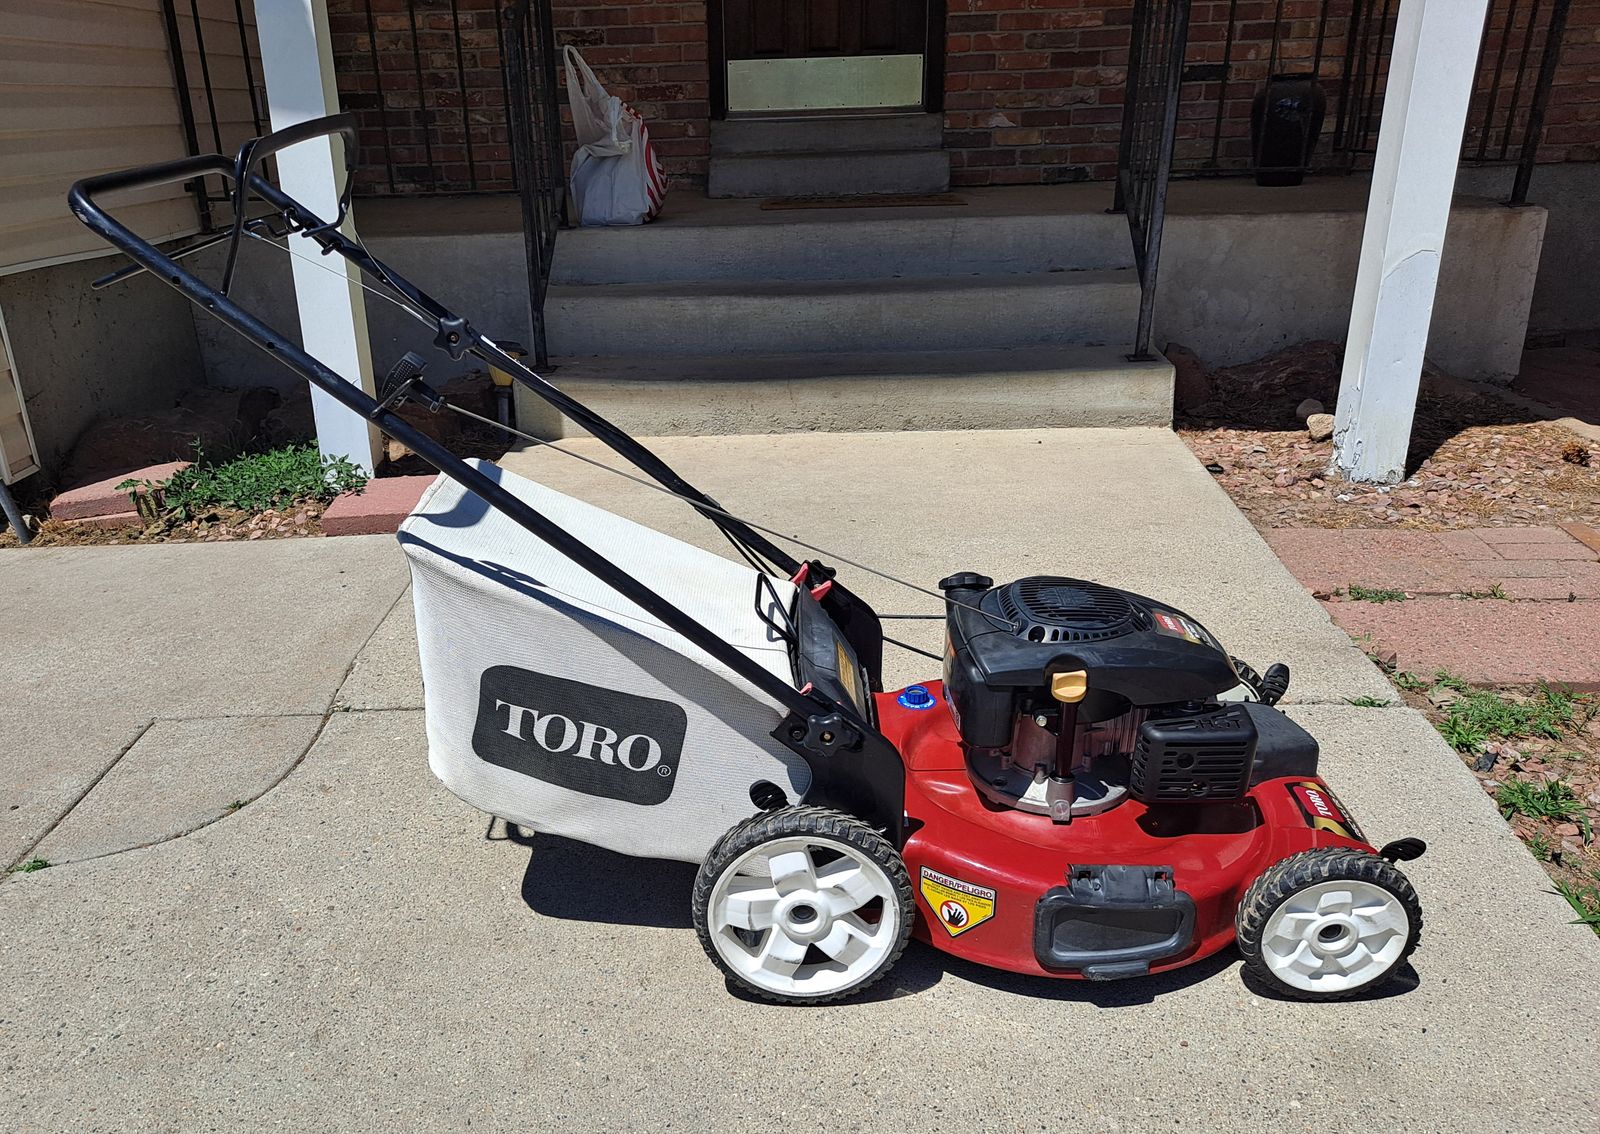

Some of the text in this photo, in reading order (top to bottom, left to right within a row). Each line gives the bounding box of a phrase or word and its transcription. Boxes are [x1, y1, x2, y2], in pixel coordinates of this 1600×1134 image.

[495, 698, 662, 772] TORO
[1305, 789, 1333, 817] TORO
[923, 870, 992, 899] DANGER/PELIGRO
